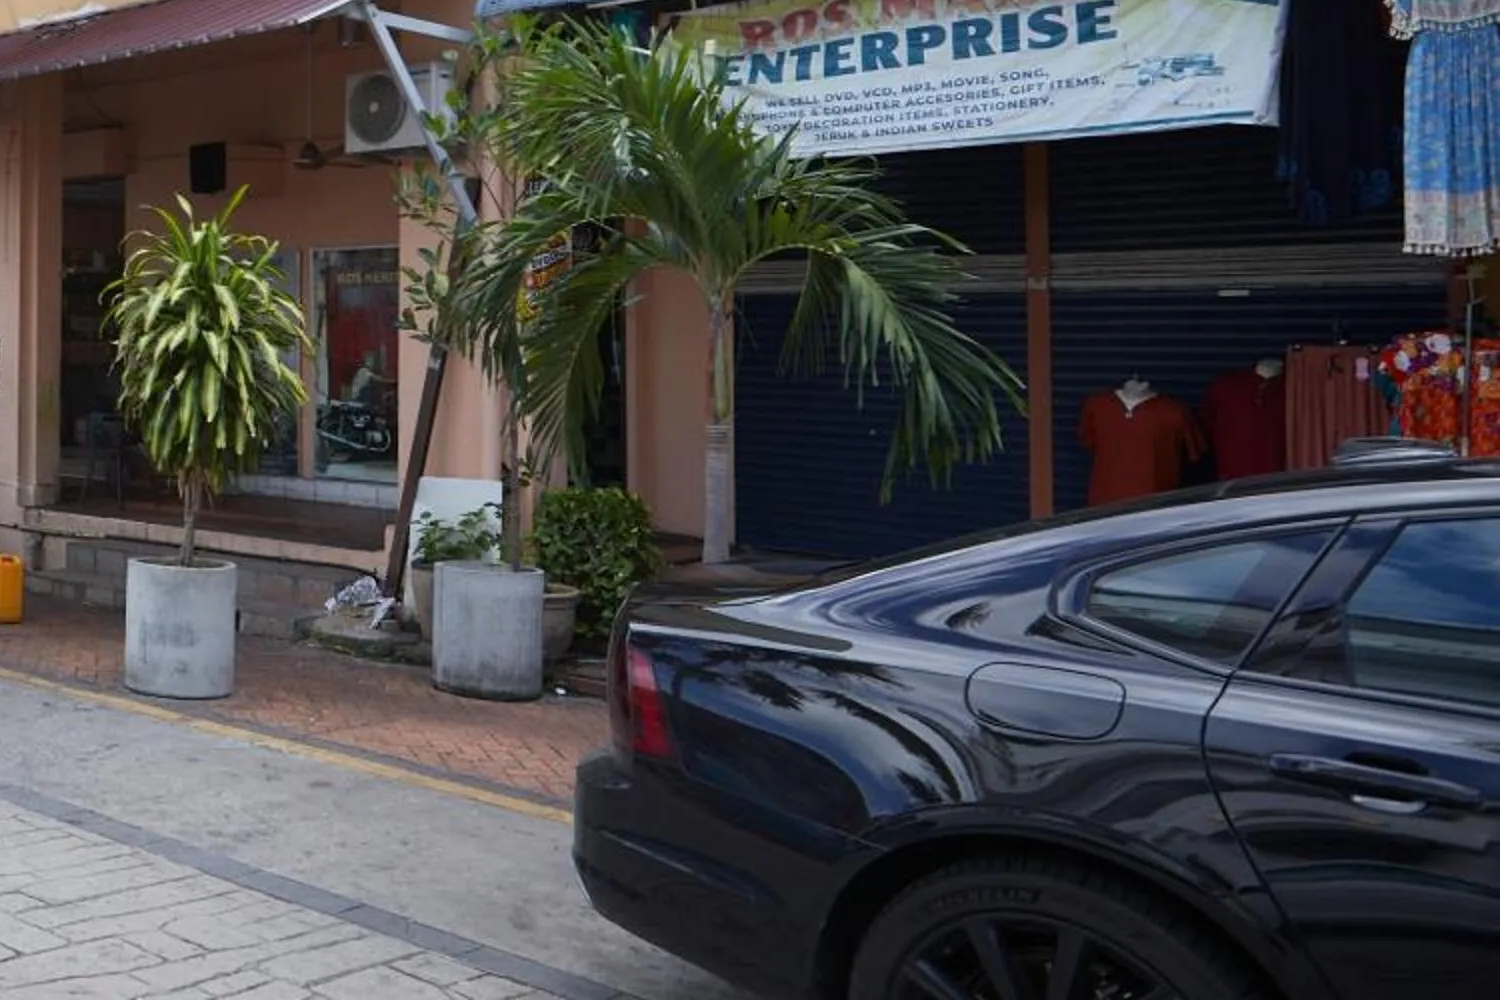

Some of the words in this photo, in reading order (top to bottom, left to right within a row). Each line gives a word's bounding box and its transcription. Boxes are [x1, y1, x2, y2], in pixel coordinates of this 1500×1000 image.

[823, 98, 902, 116] COMPUTER
[1009, 82, 1046, 96] GIFT
[1051, 74, 1107, 91] ITEMS,
[803, 113, 895, 132] DECORATION
[875, 123, 927, 137] INDIAN
[931, 116, 995, 132] SWEETS
